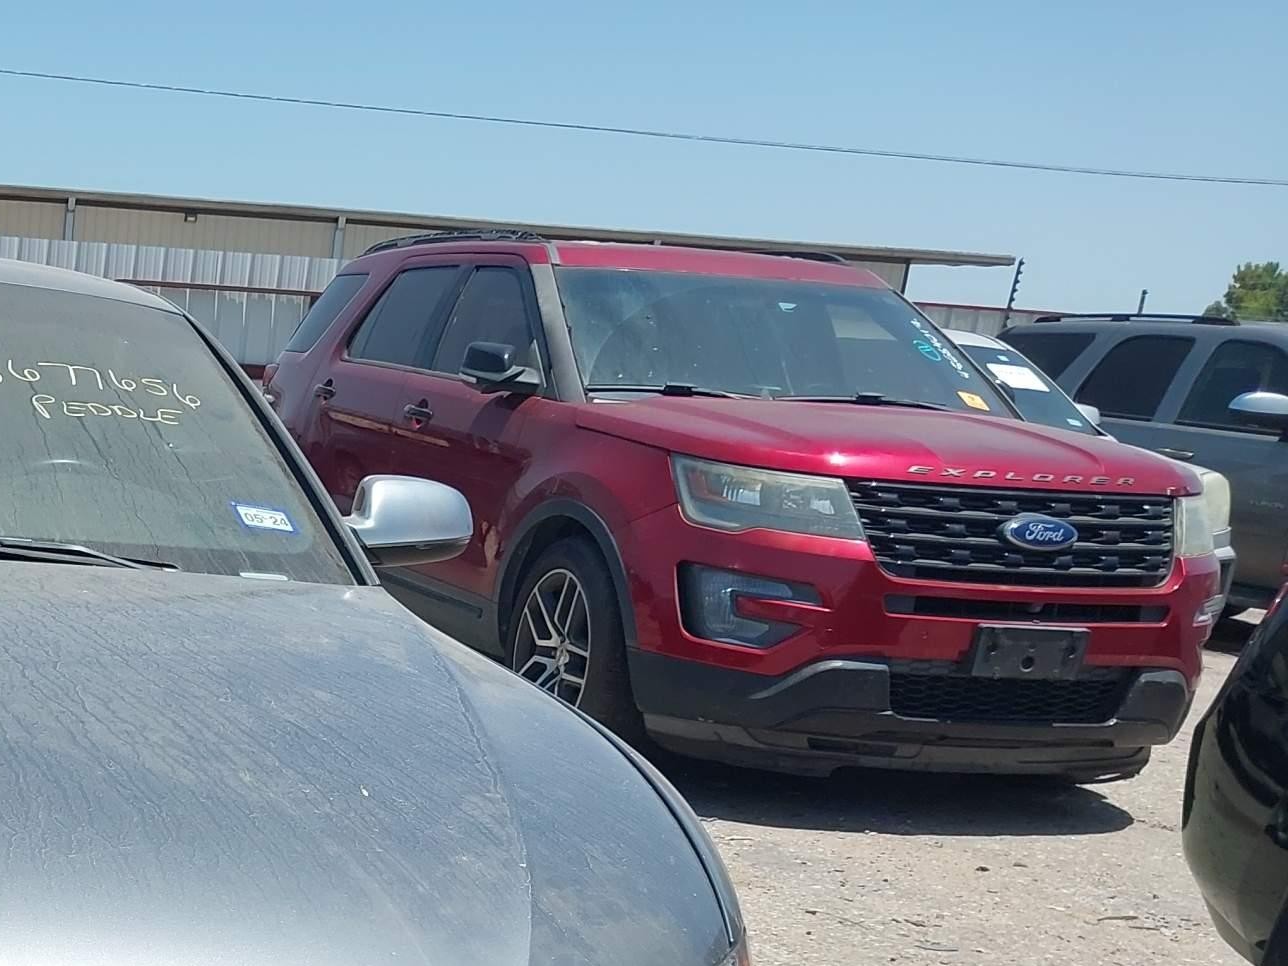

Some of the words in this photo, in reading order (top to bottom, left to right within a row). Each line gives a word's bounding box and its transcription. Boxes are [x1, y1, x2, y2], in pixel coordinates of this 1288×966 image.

[32, 394, 182, 424] PEDDLE
[907, 465, 1135, 486] EXPLORER
[1025, 522, 1064, 542] Ford
